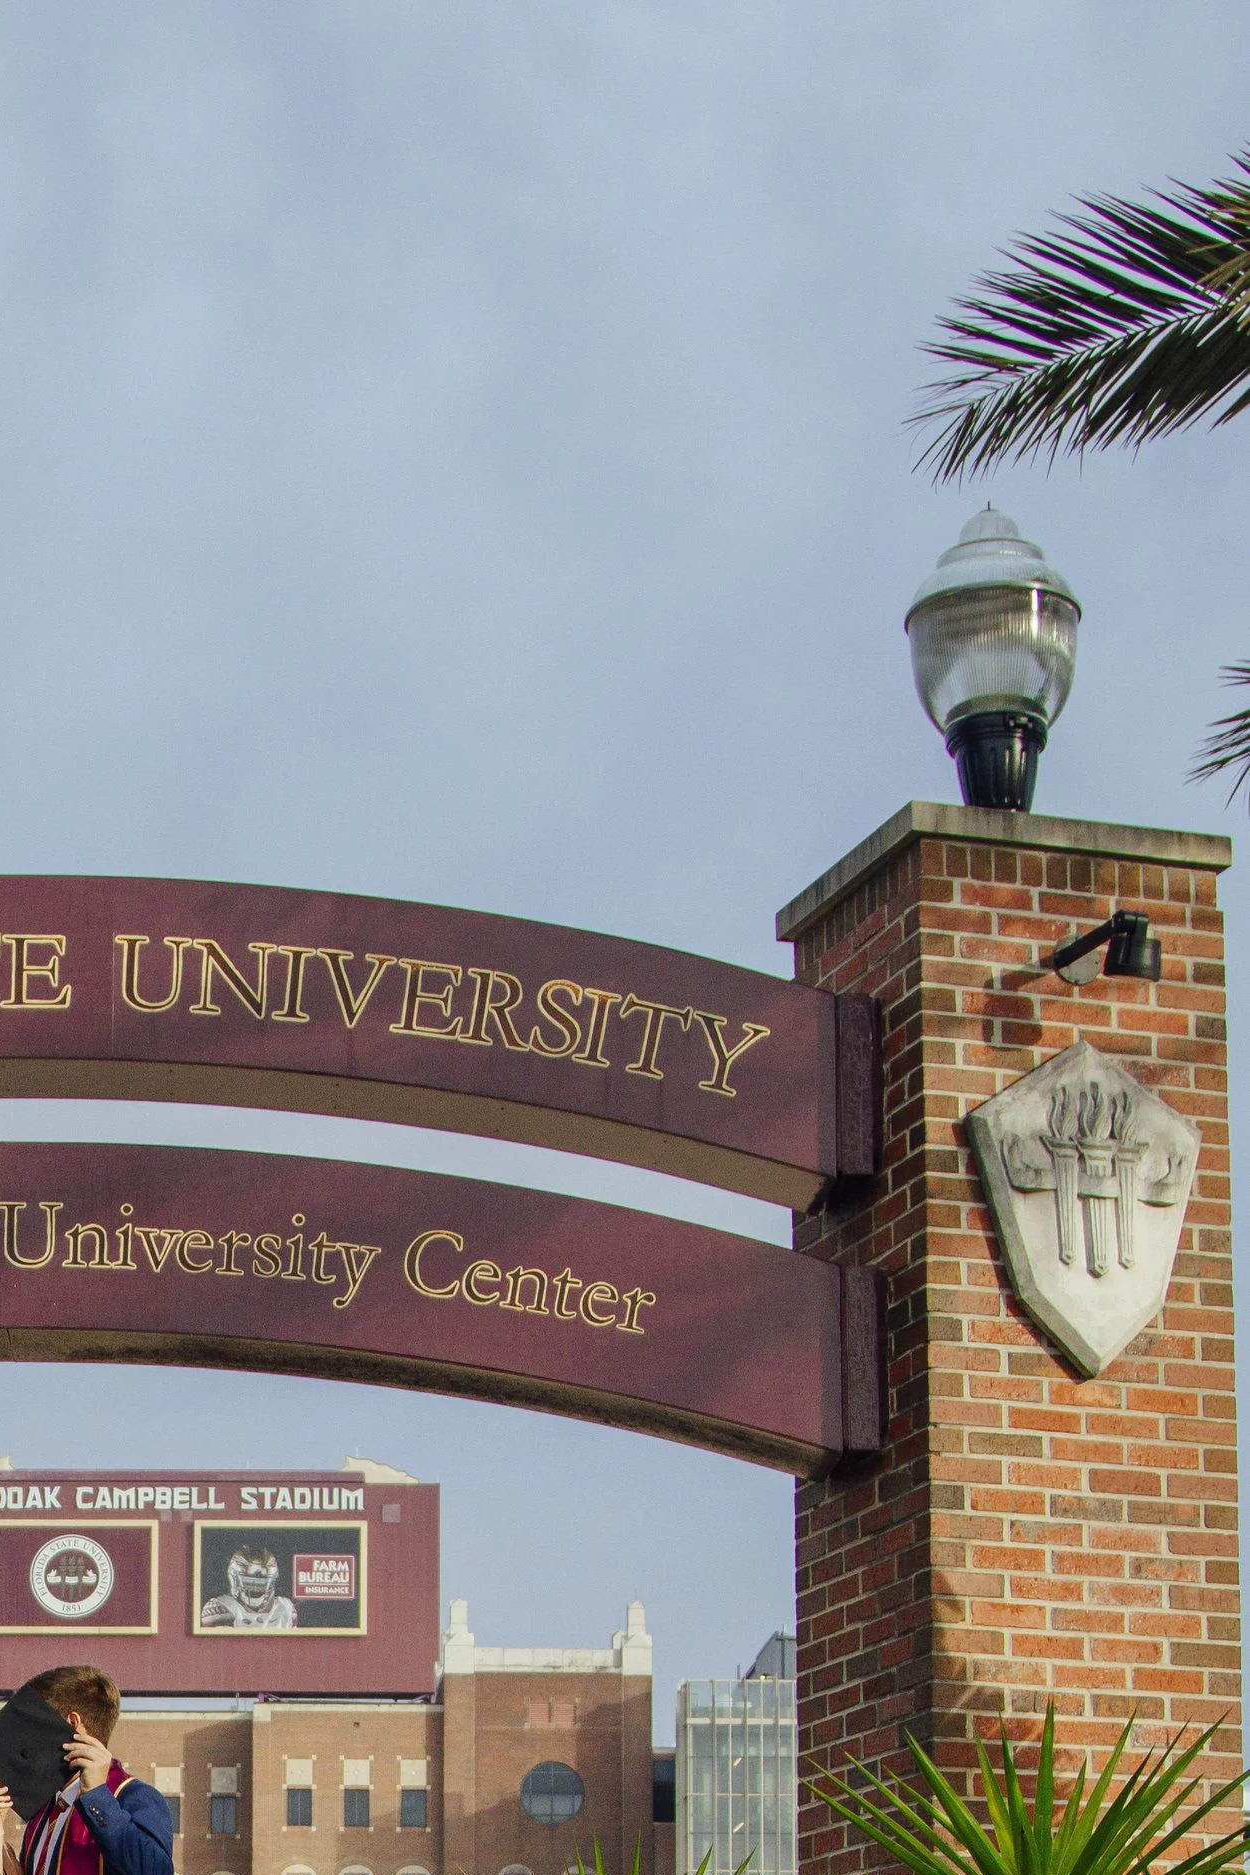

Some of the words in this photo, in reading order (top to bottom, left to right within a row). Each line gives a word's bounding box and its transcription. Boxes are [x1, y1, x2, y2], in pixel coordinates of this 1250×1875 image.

[115, 935, 770, 1098] UNIVERSITY
[404, 1229, 656, 1334] Center
[76, 1486, 225, 1510] CAMPBELL
[240, 1486, 365, 1510] STADIUM
[35, 1553, 49, 1598] FLORIDA
[50, 1540, 79, 1553] STATE
[82, 1542, 108, 1598] UNIVERSITY
[312, 1560, 349, 1571] FARM
[299, 1572, 350, 1583] BUREAU
[305, 1586, 349, 1594] INSURANCE
[61, 1603, 82, 1612] 1851
